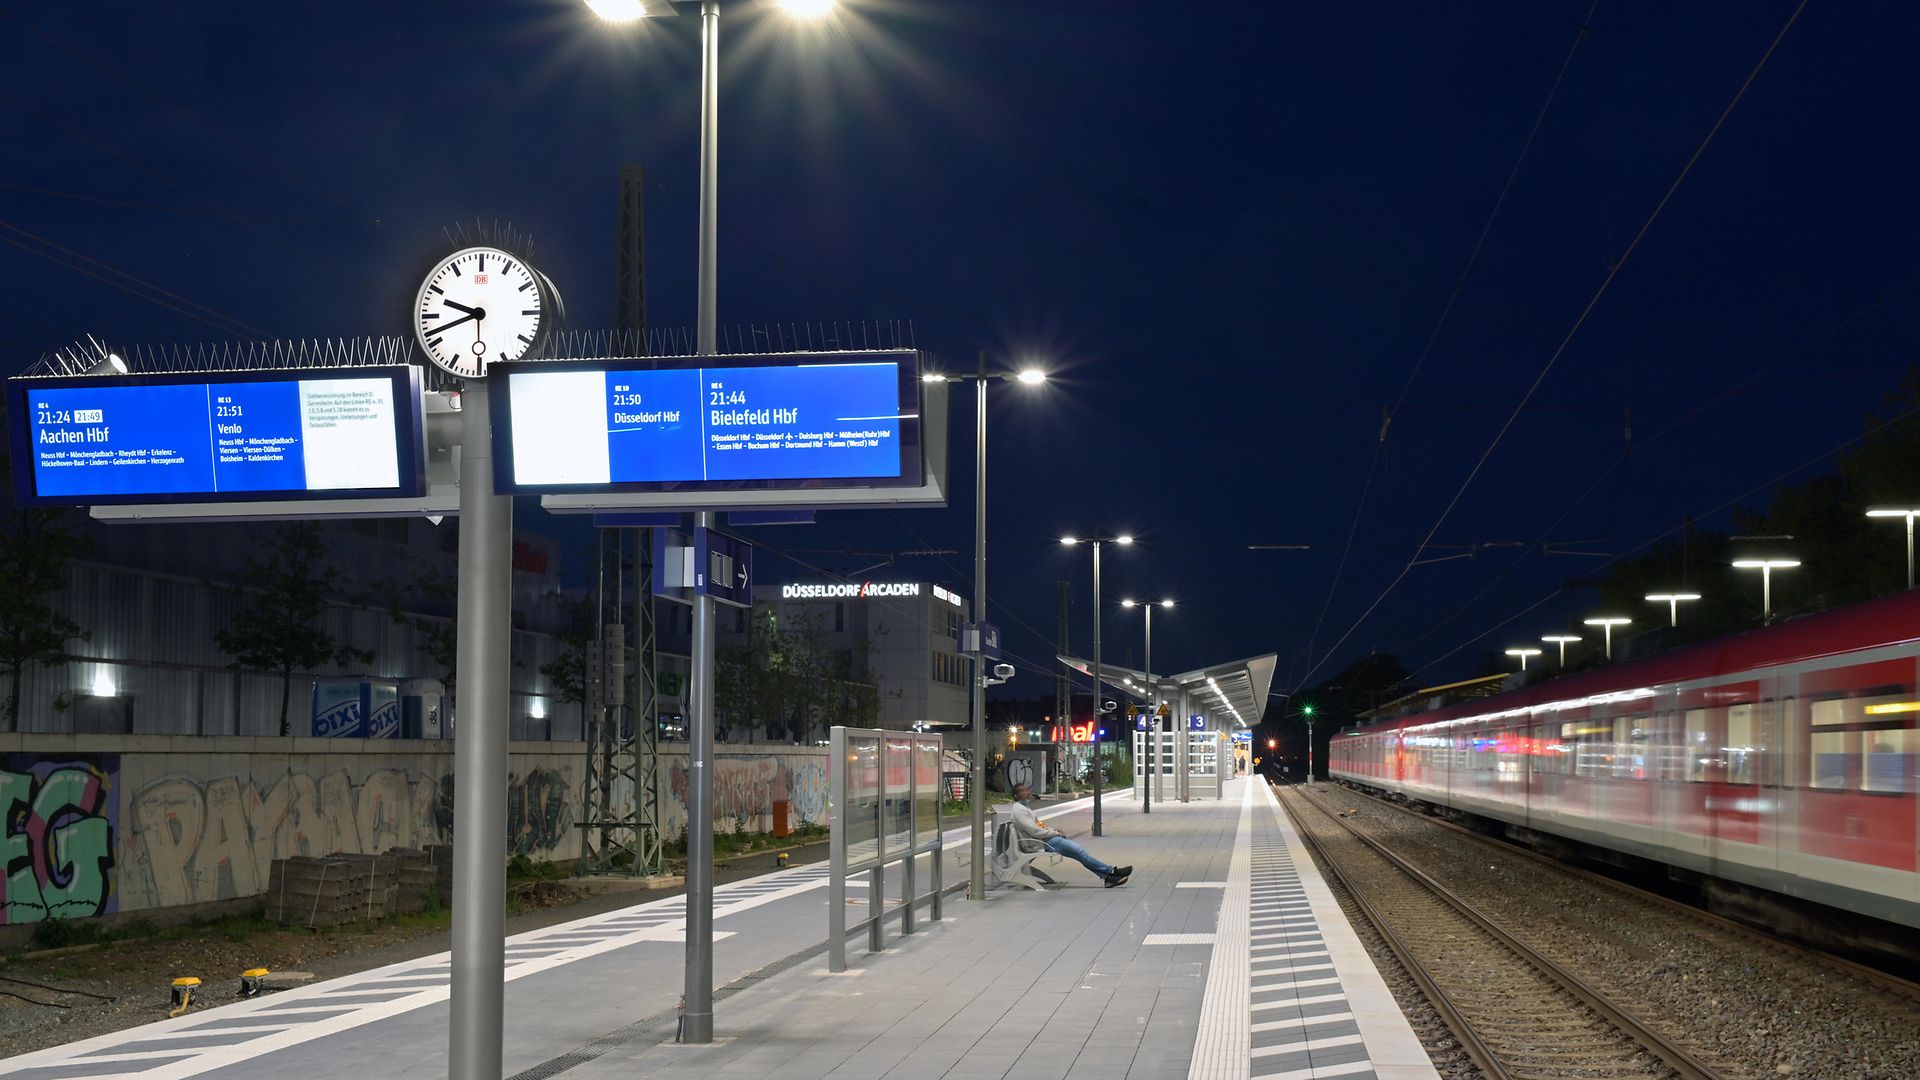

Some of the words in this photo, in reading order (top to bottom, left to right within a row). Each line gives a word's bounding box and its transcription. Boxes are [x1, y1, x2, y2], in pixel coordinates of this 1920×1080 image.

[476, 276, 487, 284] DB
[614, 394, 641, 405] 21:50
[710, 391, 746, 405] 21:44
[217, 405, 243, 417] 21:51
[38, 411, 71, 424] 21:24
[77, 412, 101, 422] 21:49
[614, 411, 662, 423] Düsseldorf
[663, 411, 680, 422] Hbf
[711, 409, 770, 426] Bielefeld
[773, 408, 798, 424] Hbf
[217, 423, 242, 434] Venlo
[40, 428, 84, 444] Aachen
[87, 427, 109, 443] Hbf
[711, 434, 740, 442] Düsseldorf
[740, 433, 751, 441] Hbf
[799, 432, 823, 440] Duisburg
[785, 441, 812, 449] Dortmund
[813, 440, 823, 448] Hbf
[828, 440, 846, 448] Hamm
[868, 439, 879, 447] Hbf
[56, 451, 66, 459] Hbf
[137, 449, 147, 457] Hbf
[782, 583, 861, 598] DÜSSELDORF
[1195, 716, 1204, 727] 3
